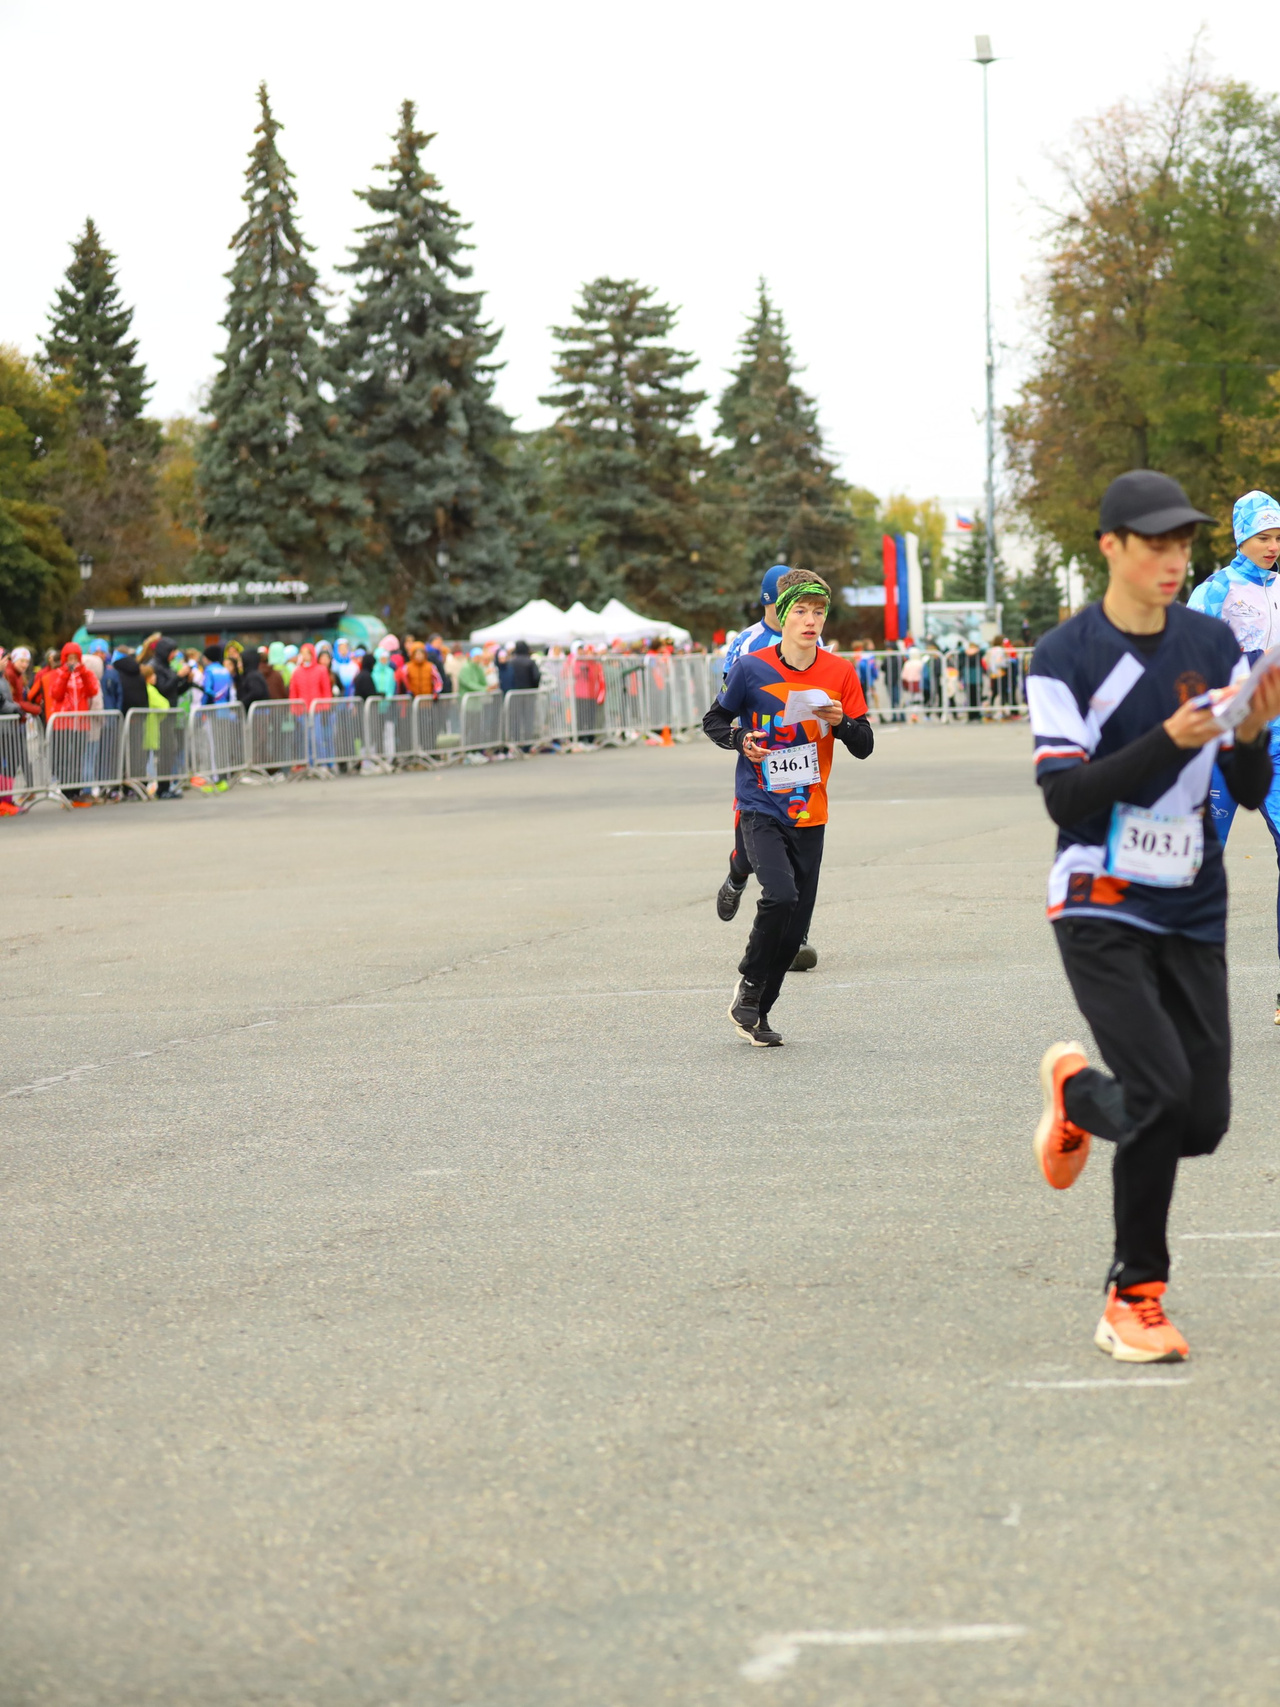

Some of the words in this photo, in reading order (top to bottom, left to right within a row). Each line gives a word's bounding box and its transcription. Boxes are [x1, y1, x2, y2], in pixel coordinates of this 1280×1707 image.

[142, 583, 239, 598] УЛЬЯНОВСКАЯ
[245, 581, 309, 595] ОБЛАСТЬ
[769, 755, 810, 775] 346.1
[1122, 826, 1192, 857] 303.1
